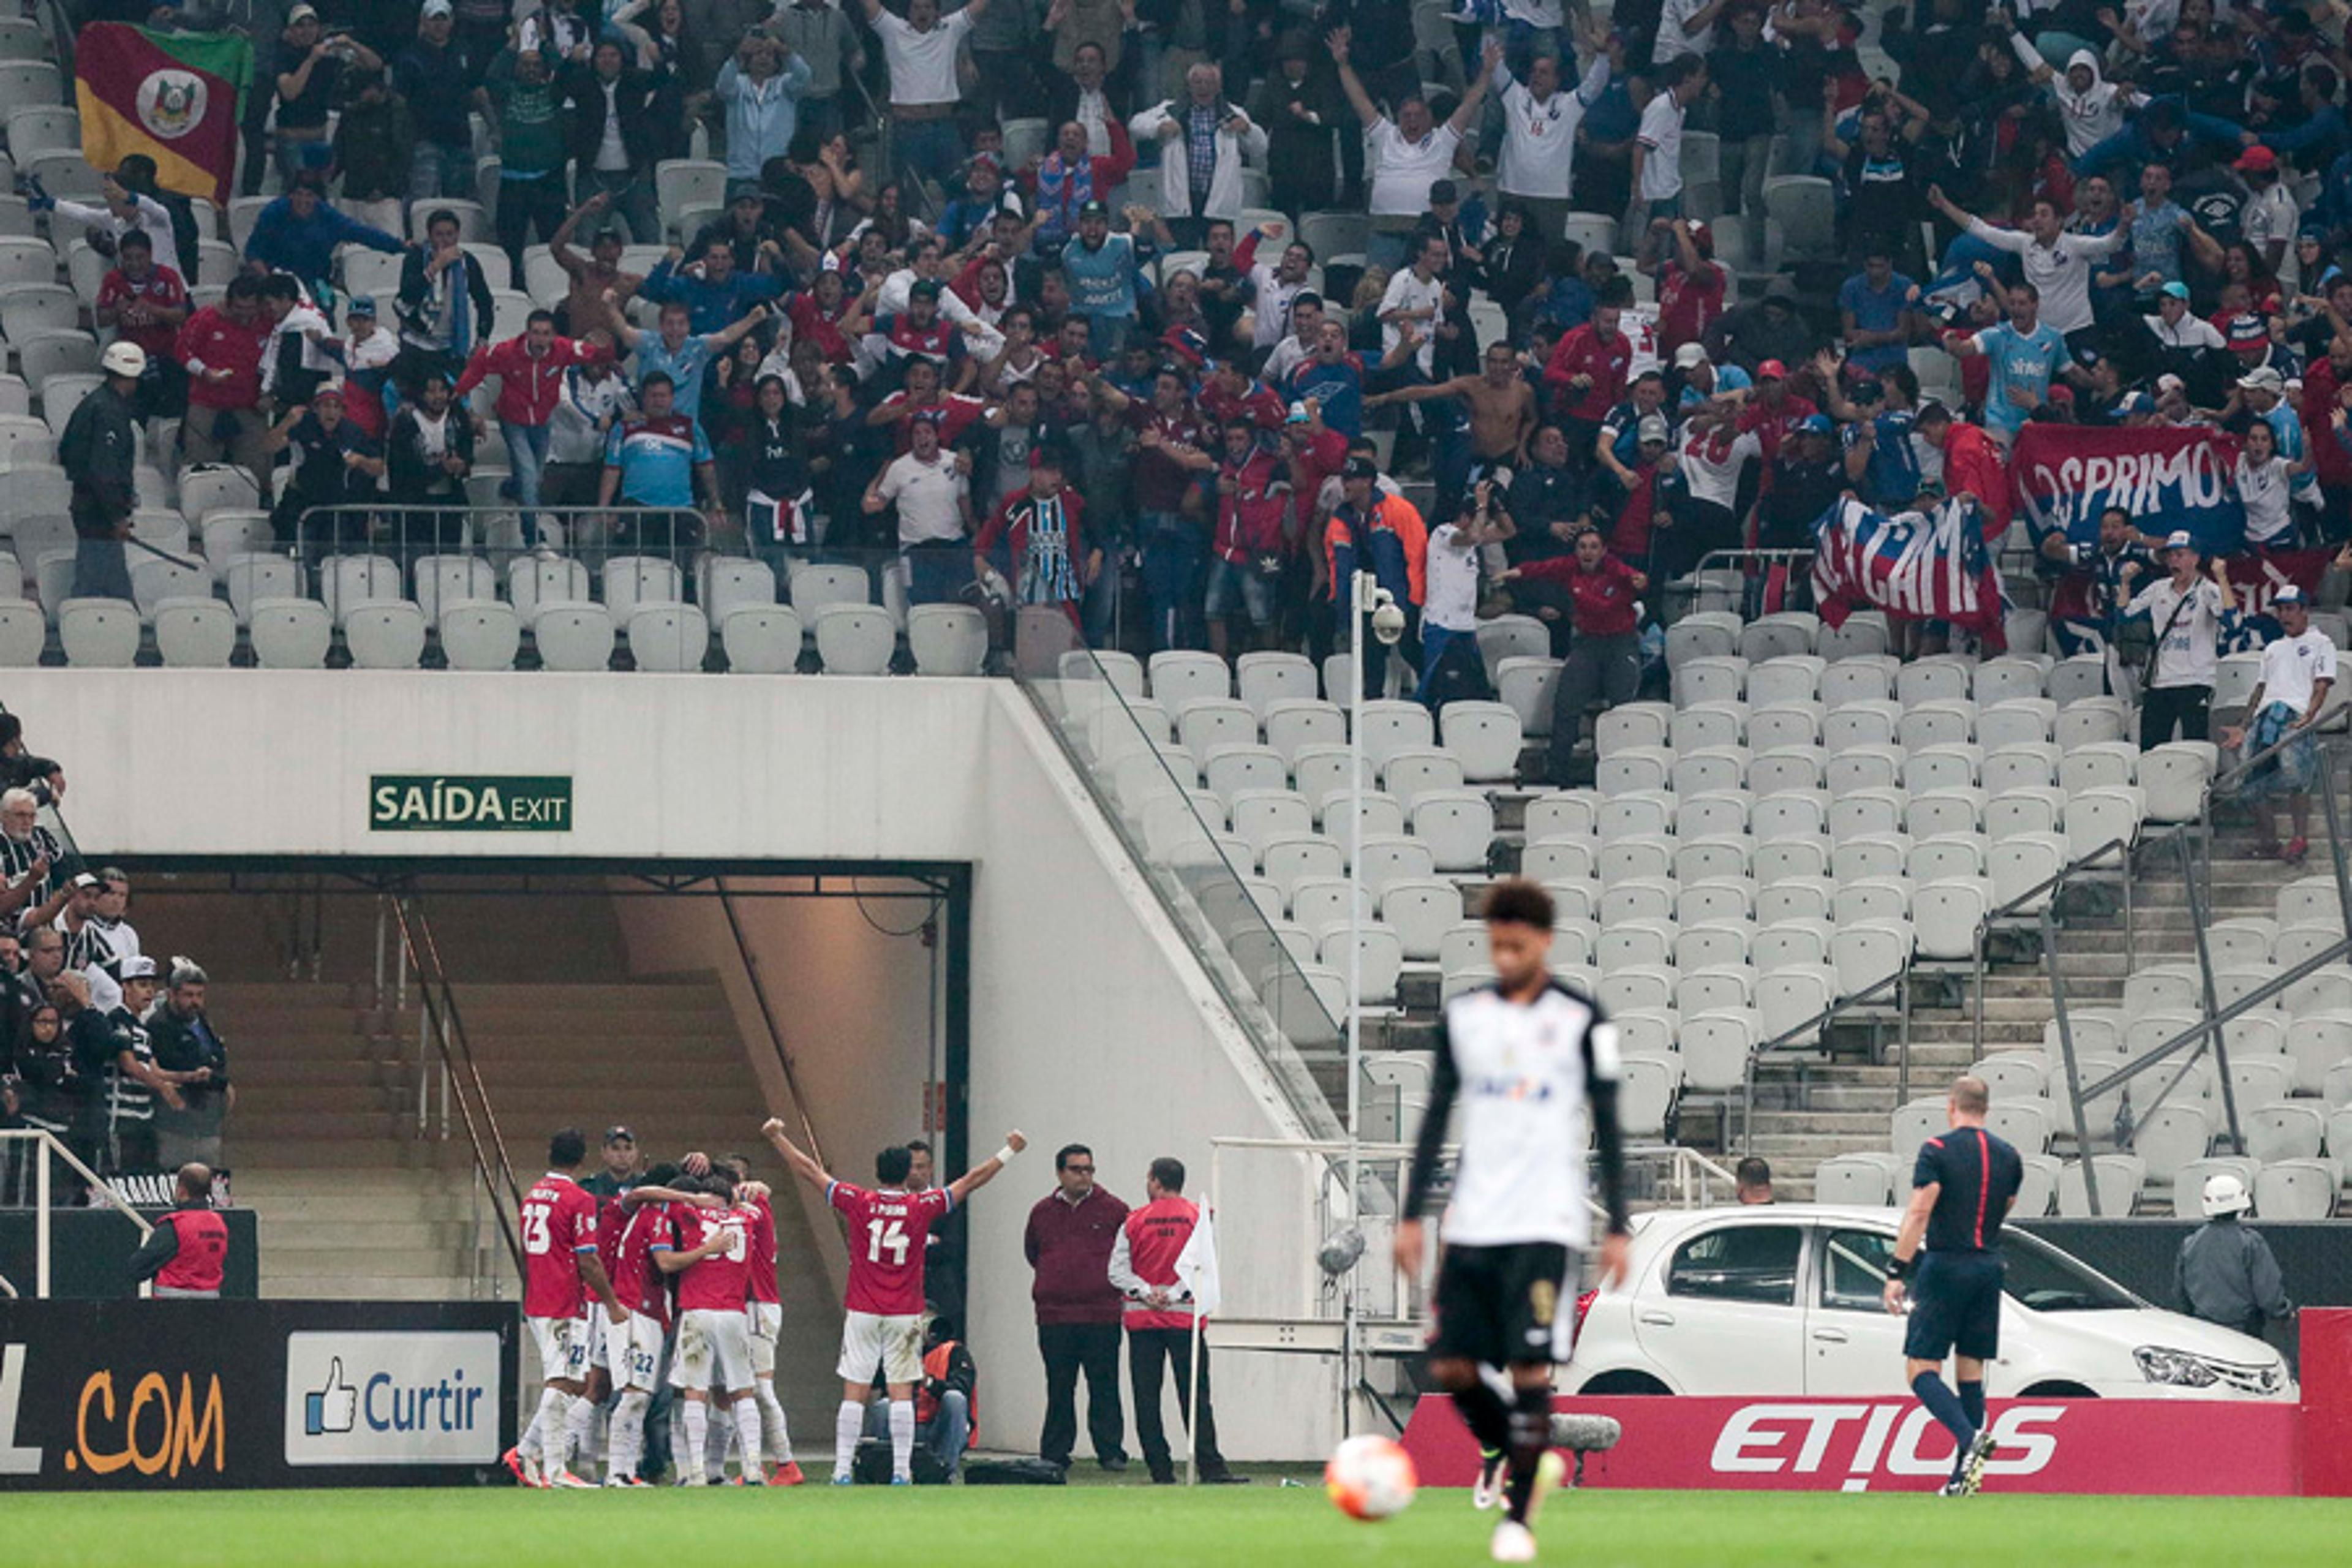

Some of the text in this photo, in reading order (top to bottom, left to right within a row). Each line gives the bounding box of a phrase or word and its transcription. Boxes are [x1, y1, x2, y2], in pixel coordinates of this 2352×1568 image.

[375, 779, 566, 822] SAÍDA EXIT
[867, 1218, 910, 1265] 14
[635, 1352, 654, 1373] 22
[64, 1368, 225, 1479] .COM
[364, 1368, 482, 1432] Curtir
